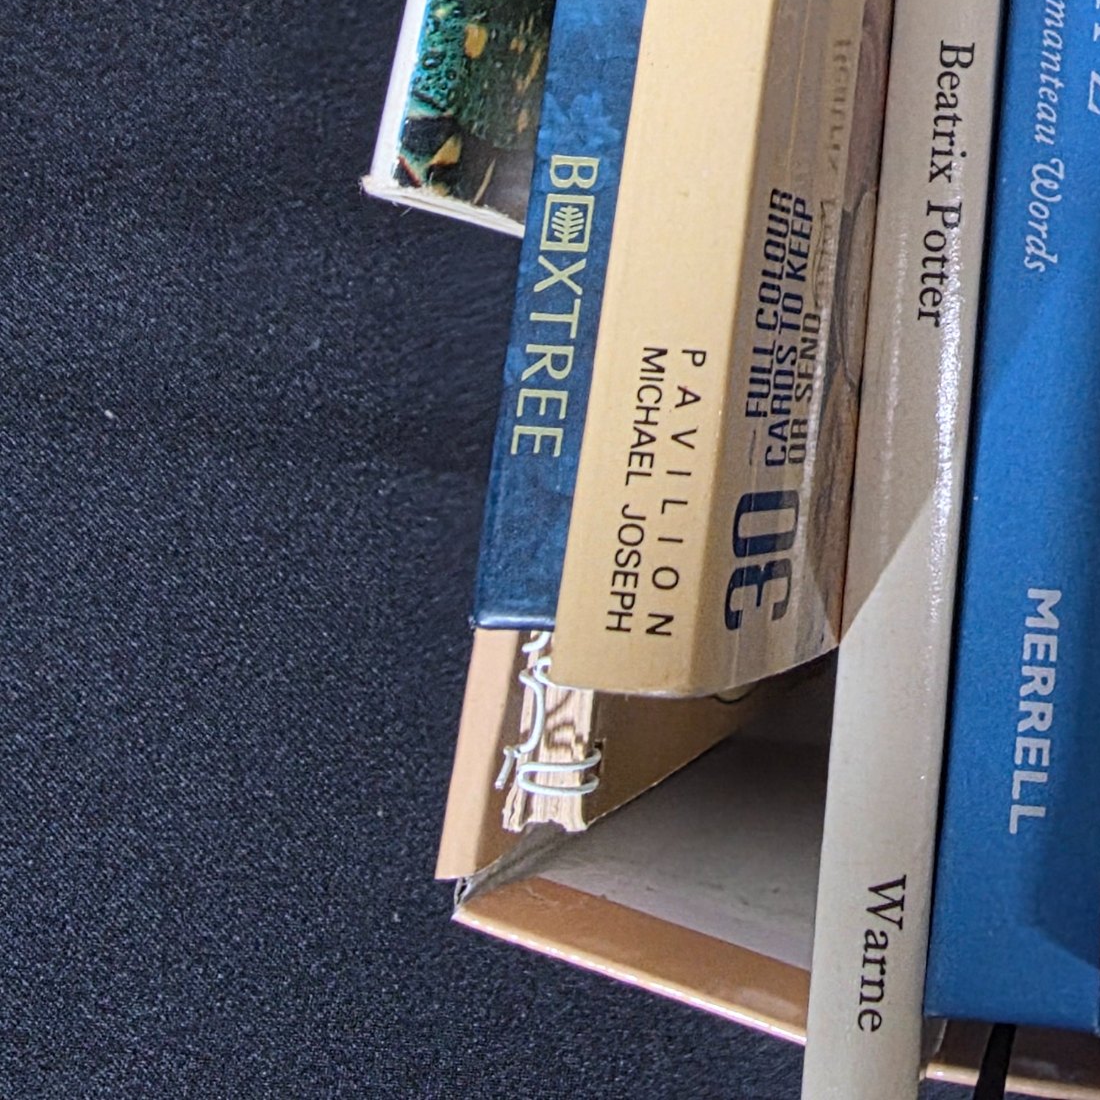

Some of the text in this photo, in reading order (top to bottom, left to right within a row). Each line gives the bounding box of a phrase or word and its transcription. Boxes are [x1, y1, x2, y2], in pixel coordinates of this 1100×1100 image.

[745, 188, 793, 418] FULL COLOUR
[916, 39, 976, 329] Beatrix Potter
[1024, 157, 1067, 273] Words
[764, 196, 815, 468] CARDS TO KEEP
[786, 311, 822, 465] OR SEND
[605, 346, 668, 634] MICHAEL JOSEPH
[646, 347, 707, 637] PAVILION
[724, 489, 800, 632] 30
[1009, 587, 1062, 835] MERRELL
[858, 874, 908, 1034] Warne
